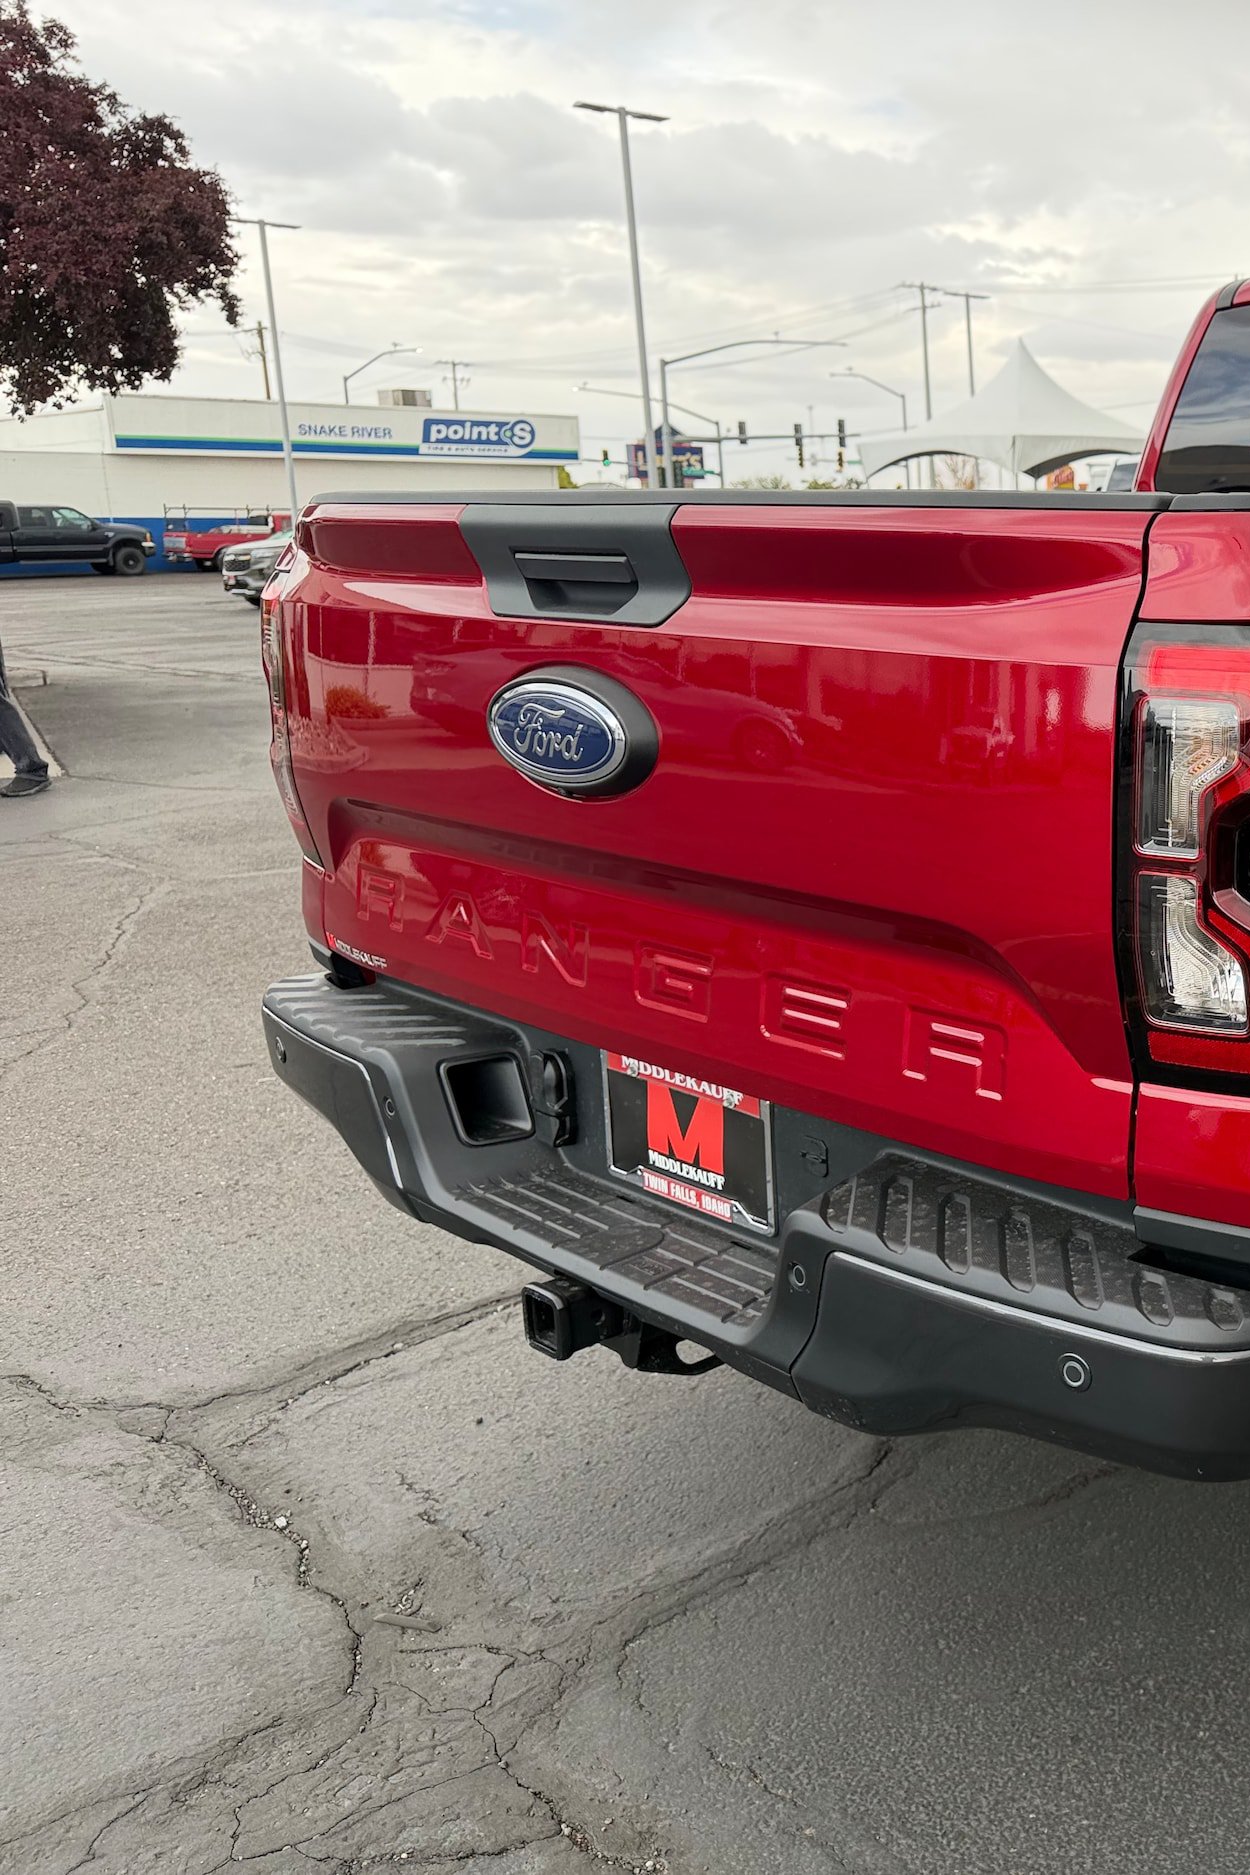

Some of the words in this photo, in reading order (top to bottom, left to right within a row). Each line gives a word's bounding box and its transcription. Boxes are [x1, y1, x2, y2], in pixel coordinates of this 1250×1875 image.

[298, 423, 348, 438] SNAKE
[350, 426, 393, 439] RIVER
[430, 422, 500, 443] point
[514, 703, 583, 762] Ford
[356, 861, 1009, 1101] RANGER
[646, 1079, 724, 1175] M
[648, 1150, 726, 1190] MIDDLEKAUFF
[643, 1172, 668, 1192] TWIN
[670, 1179, 700, 1208] FALLS,
[702, 1195, 732, 1218] IDAHO
